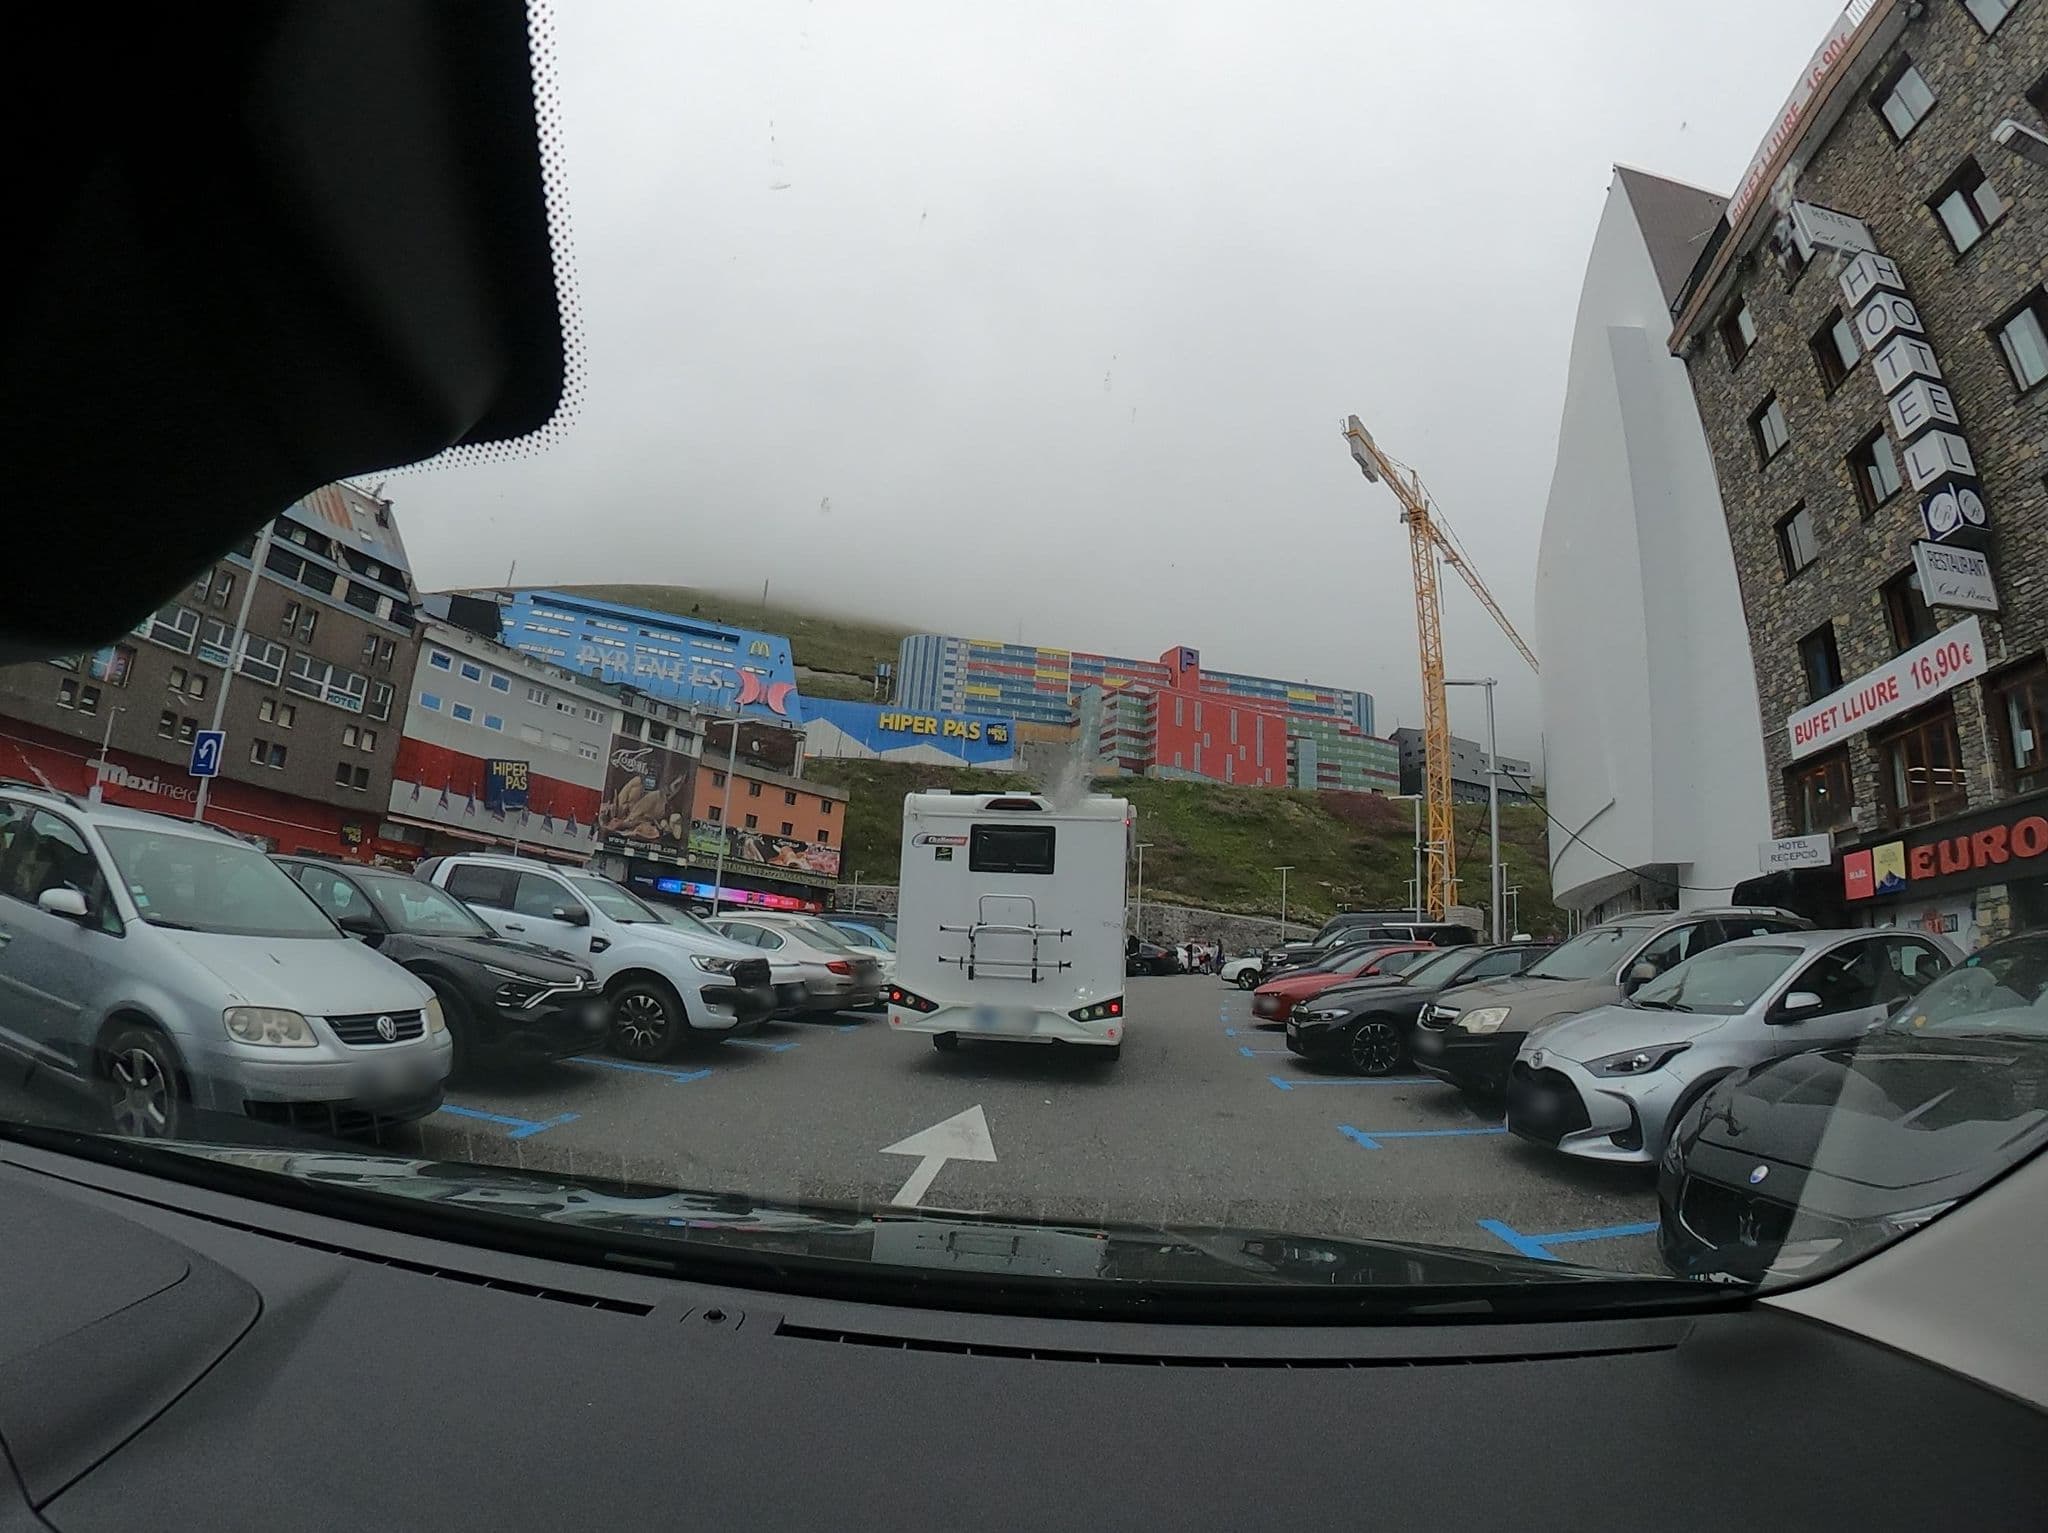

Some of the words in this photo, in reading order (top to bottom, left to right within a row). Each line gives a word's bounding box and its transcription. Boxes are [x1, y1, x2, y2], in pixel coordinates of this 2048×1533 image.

[1846, 261, 1935, 480] HOTEL
[1872, 257, 1967, 469] HOTEL
[1926, 550, 1986, 577] RESTAURANT
[1794, 705, 1838, 746] BUFET
[1842, 676, 1900, 723] LLIURE
[1910, 641, 1974, 690] 16,90€
[879, 713, 938, 736] HIPER
[943, 719, 981, 740] PAS
[492, 761, 529, 777] HIPER
[505, 776, 528, 791] PAS
[1777, 840, 1809, 851] HOTEL
[1910, 816, 2048, 881] EURO
